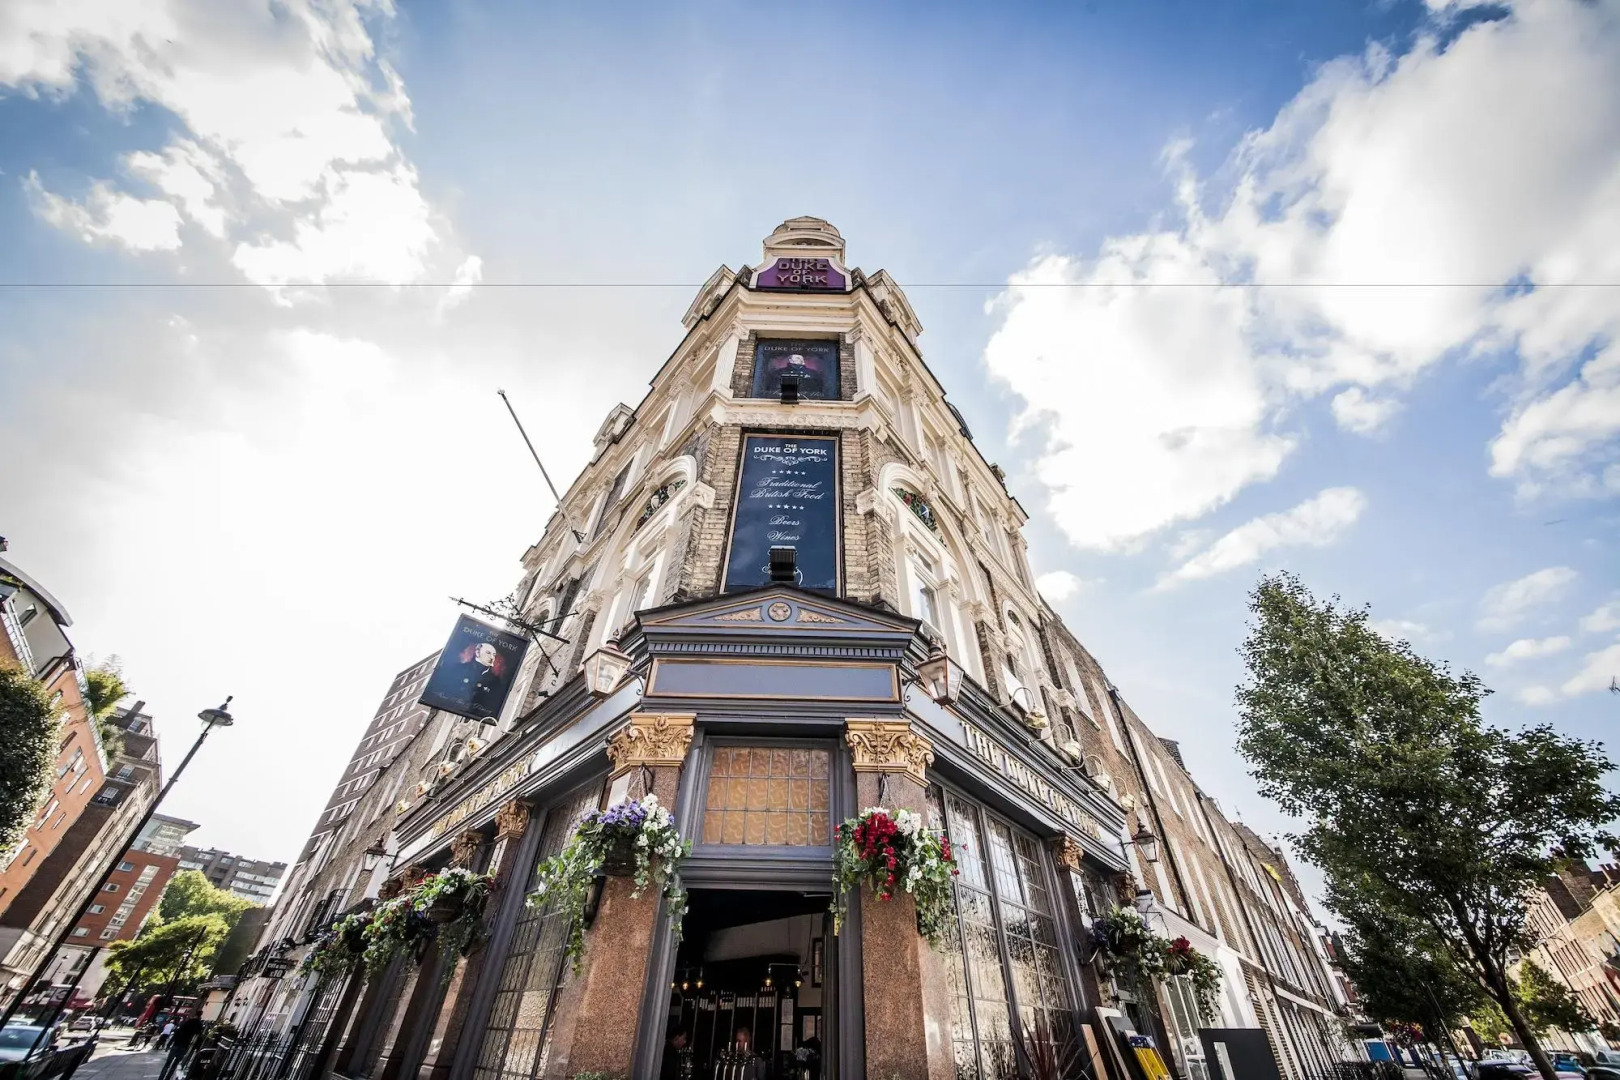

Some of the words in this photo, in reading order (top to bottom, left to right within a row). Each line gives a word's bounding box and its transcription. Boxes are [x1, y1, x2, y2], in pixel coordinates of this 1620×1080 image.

[756, 476, 823, 489] Traditional
[749, 488, 794, 498] British
[792, 489, 825, 500] Food
[769, 515, 800, 526] Beers
[767, 531, 800, 541] Wines
[463, 627, 484, 638] DUKE
[498, 640, 518, 652] YORK
